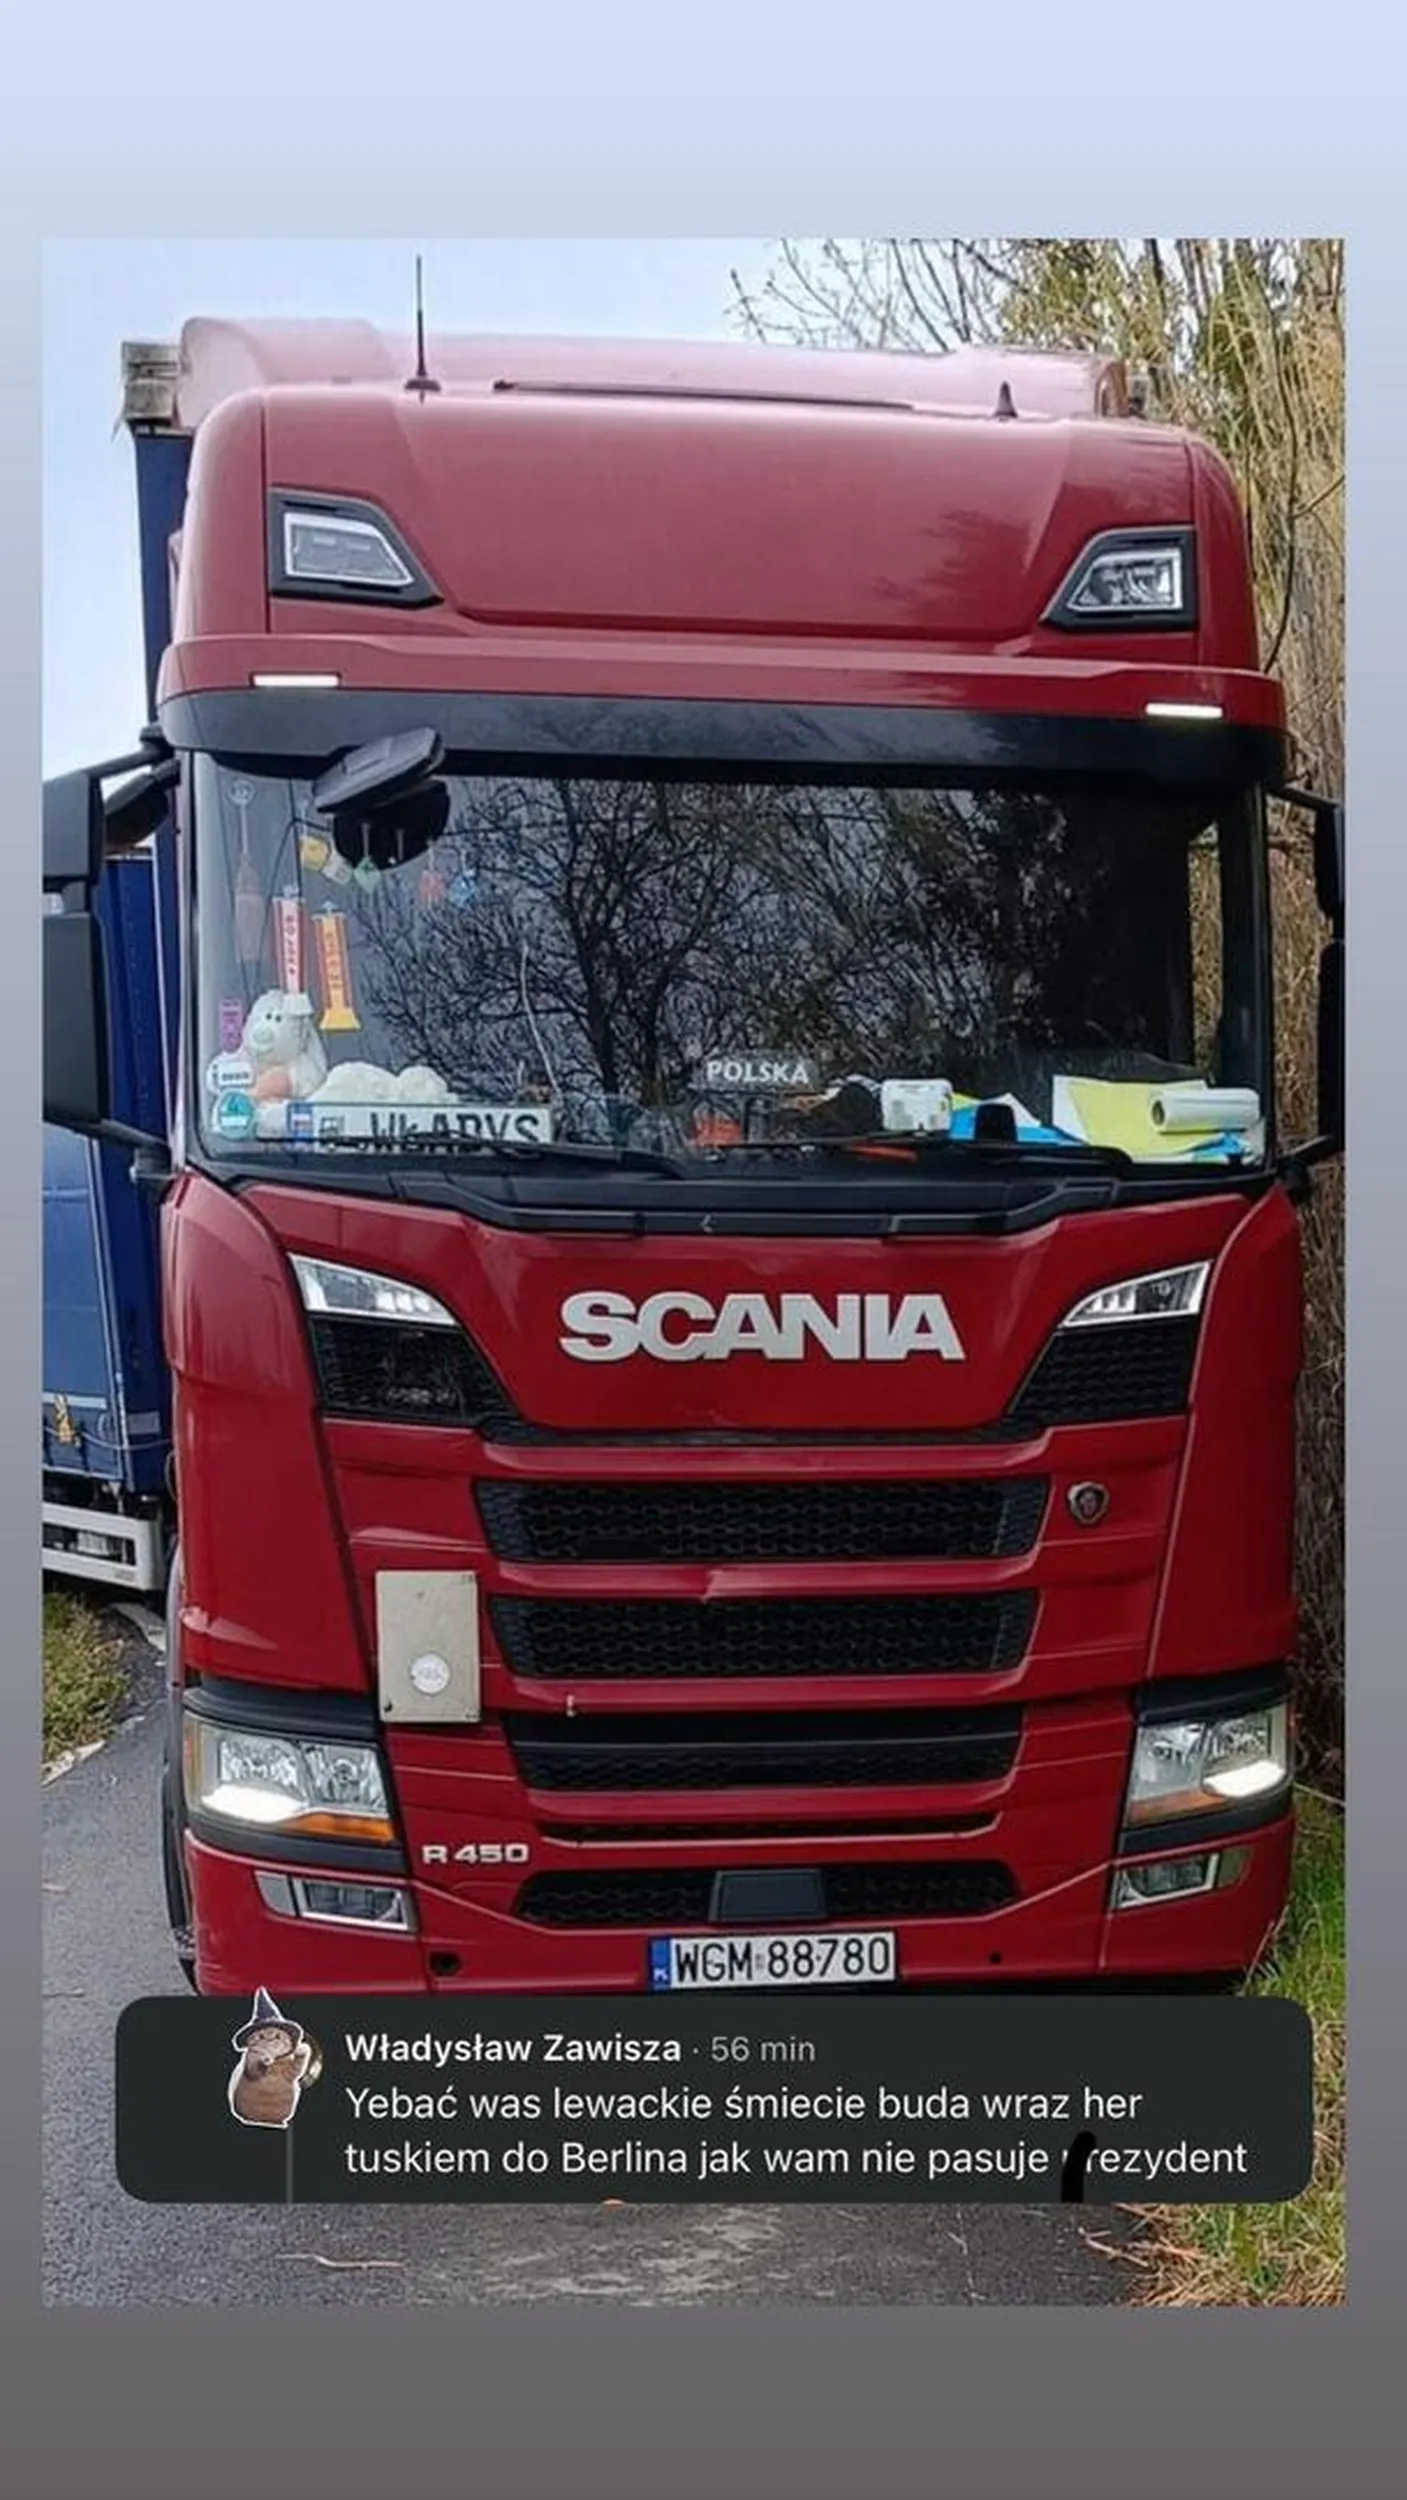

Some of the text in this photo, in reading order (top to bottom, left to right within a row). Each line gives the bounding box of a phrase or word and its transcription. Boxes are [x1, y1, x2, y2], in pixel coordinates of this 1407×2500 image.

[706, 1059, 809, 1084] POLSKA
[560, 1291, 965, 1361] SCANIA
[422, 1844, 529, 1864] R 450
[676, 1942, 752, 1982] WGM
[767, 1937, 890, 1978] 88780
